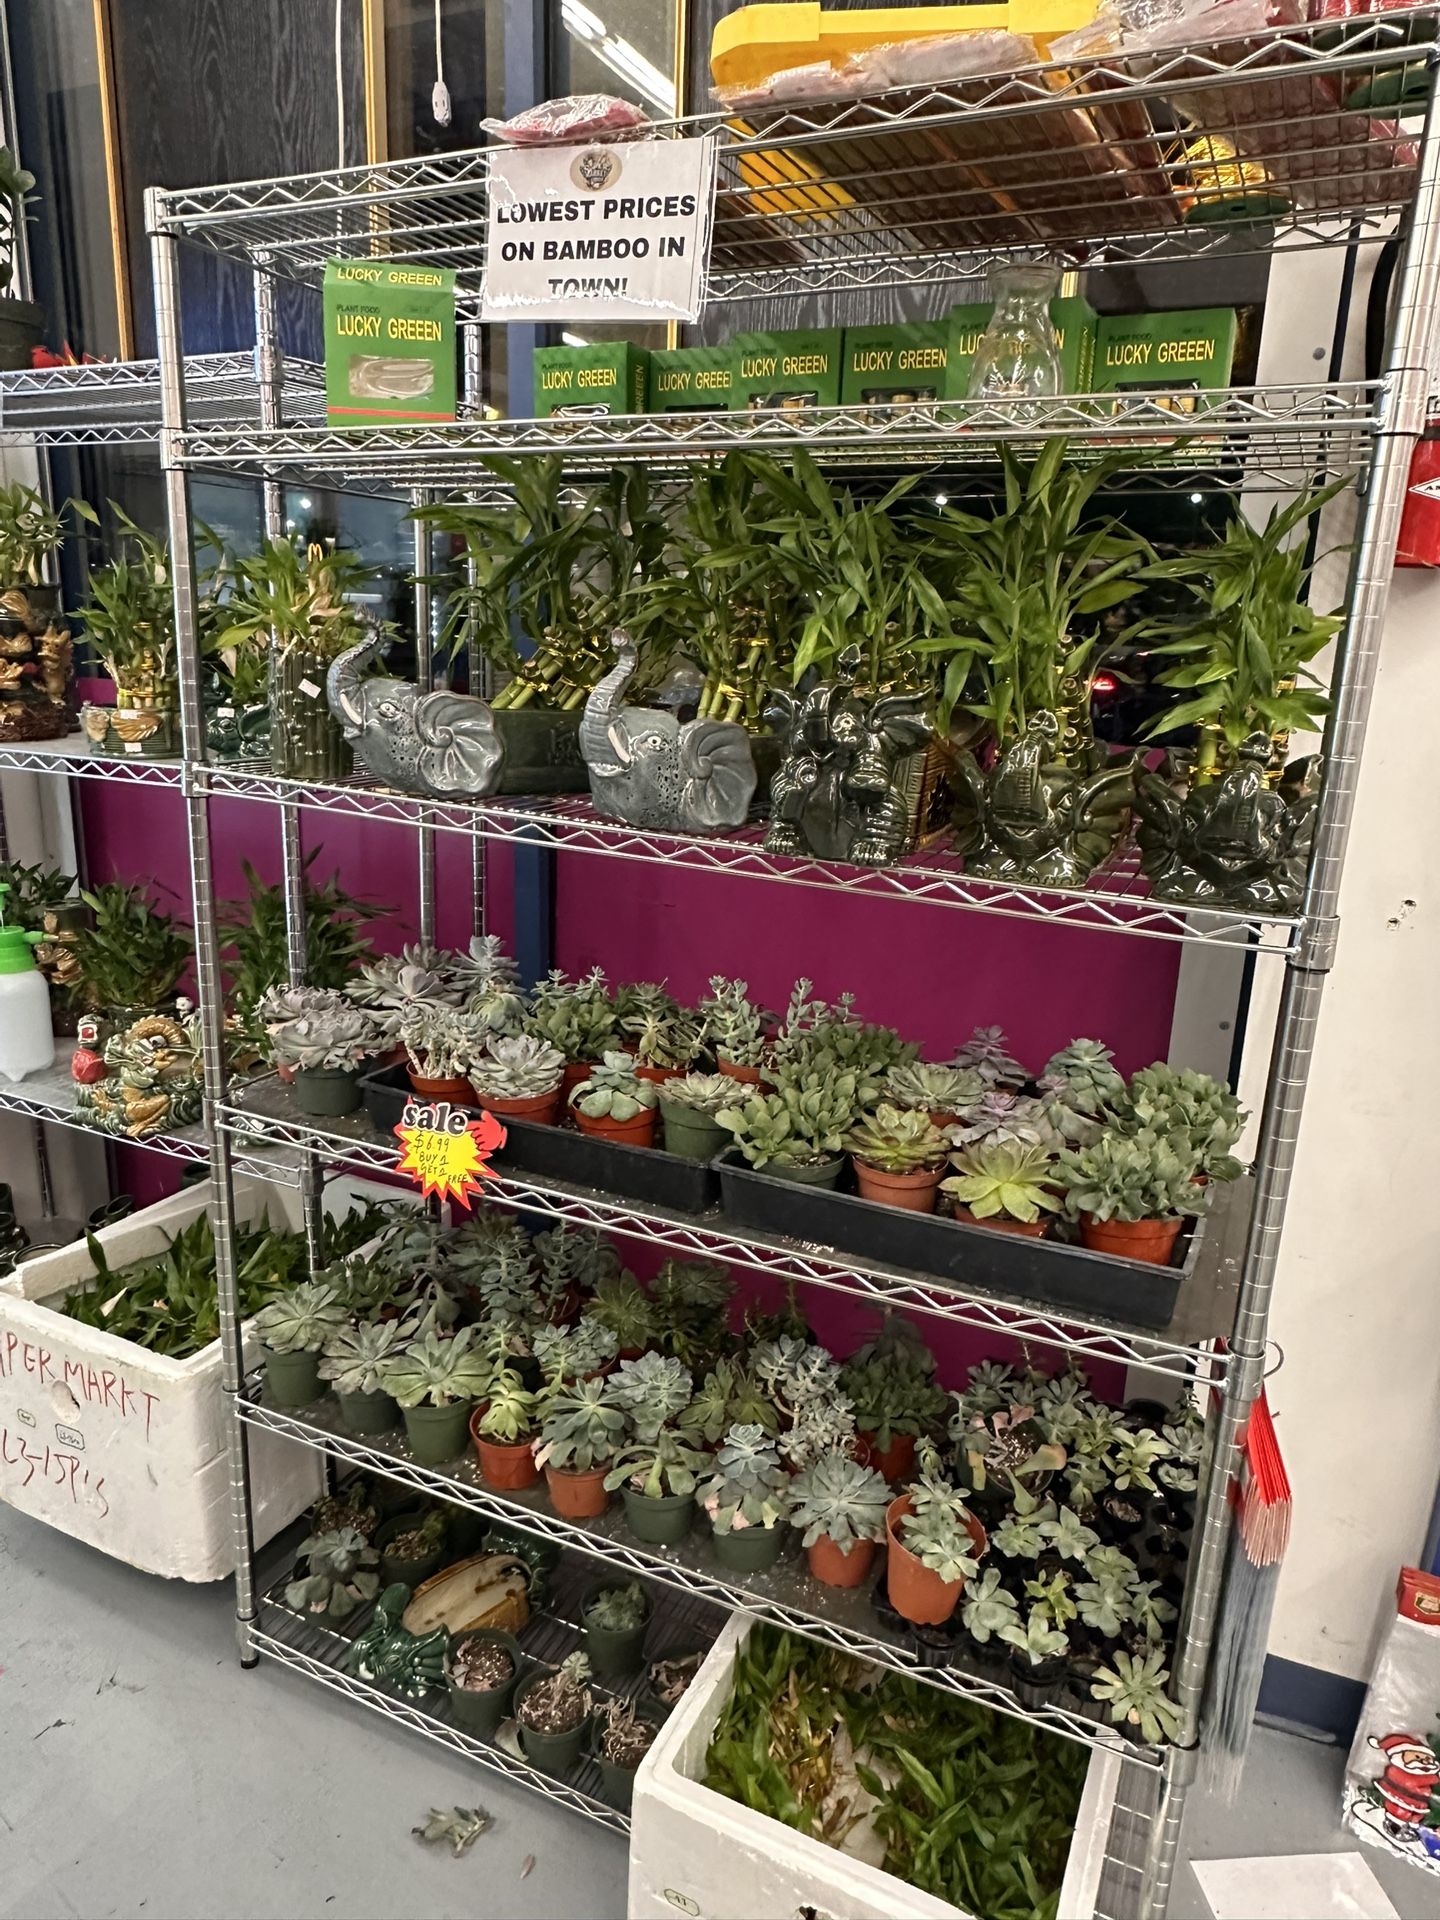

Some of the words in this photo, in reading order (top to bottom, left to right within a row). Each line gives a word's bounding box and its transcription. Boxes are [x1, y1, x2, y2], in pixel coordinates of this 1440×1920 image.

[497, 200, 595, 223] LOWEST
[603, 195, 696, 219] PRICES
[501, 242, 535, 261] ON
[543, 238, 649, 260] BAMBOO
[658, 236, 685, 257] IN
[337, 267, 383, 282] LUCKY
[388, 271, 442, 286] GREEEN
[548, 277, 628, 298] TOWN!
[337, 314, 382, 338] LUCKY
[387, 318, 442, 341] GREEEN
[853, 351, 893, 372] LUCKY
[898, 348, 948, 369] GREEEN
[1106, 343, 1152, 366] LUCKY
[1157, 339, 1215, 363] GREEEN
[741, 357, 777, 378] LUCKY
[782, 354, 828, 376] GREEEN
[542, 370, 574, 389] LUCKY
[577, 368, 617, 388] GREEEN
[658, 372, 691, 391] LUCKY
[403, 1104, 468, 1136] sale
[419, 1151, 438, 1164] BUY
[420, 1162, 438, 1175] GET
[447, 1174, 469, 1183] FREE
